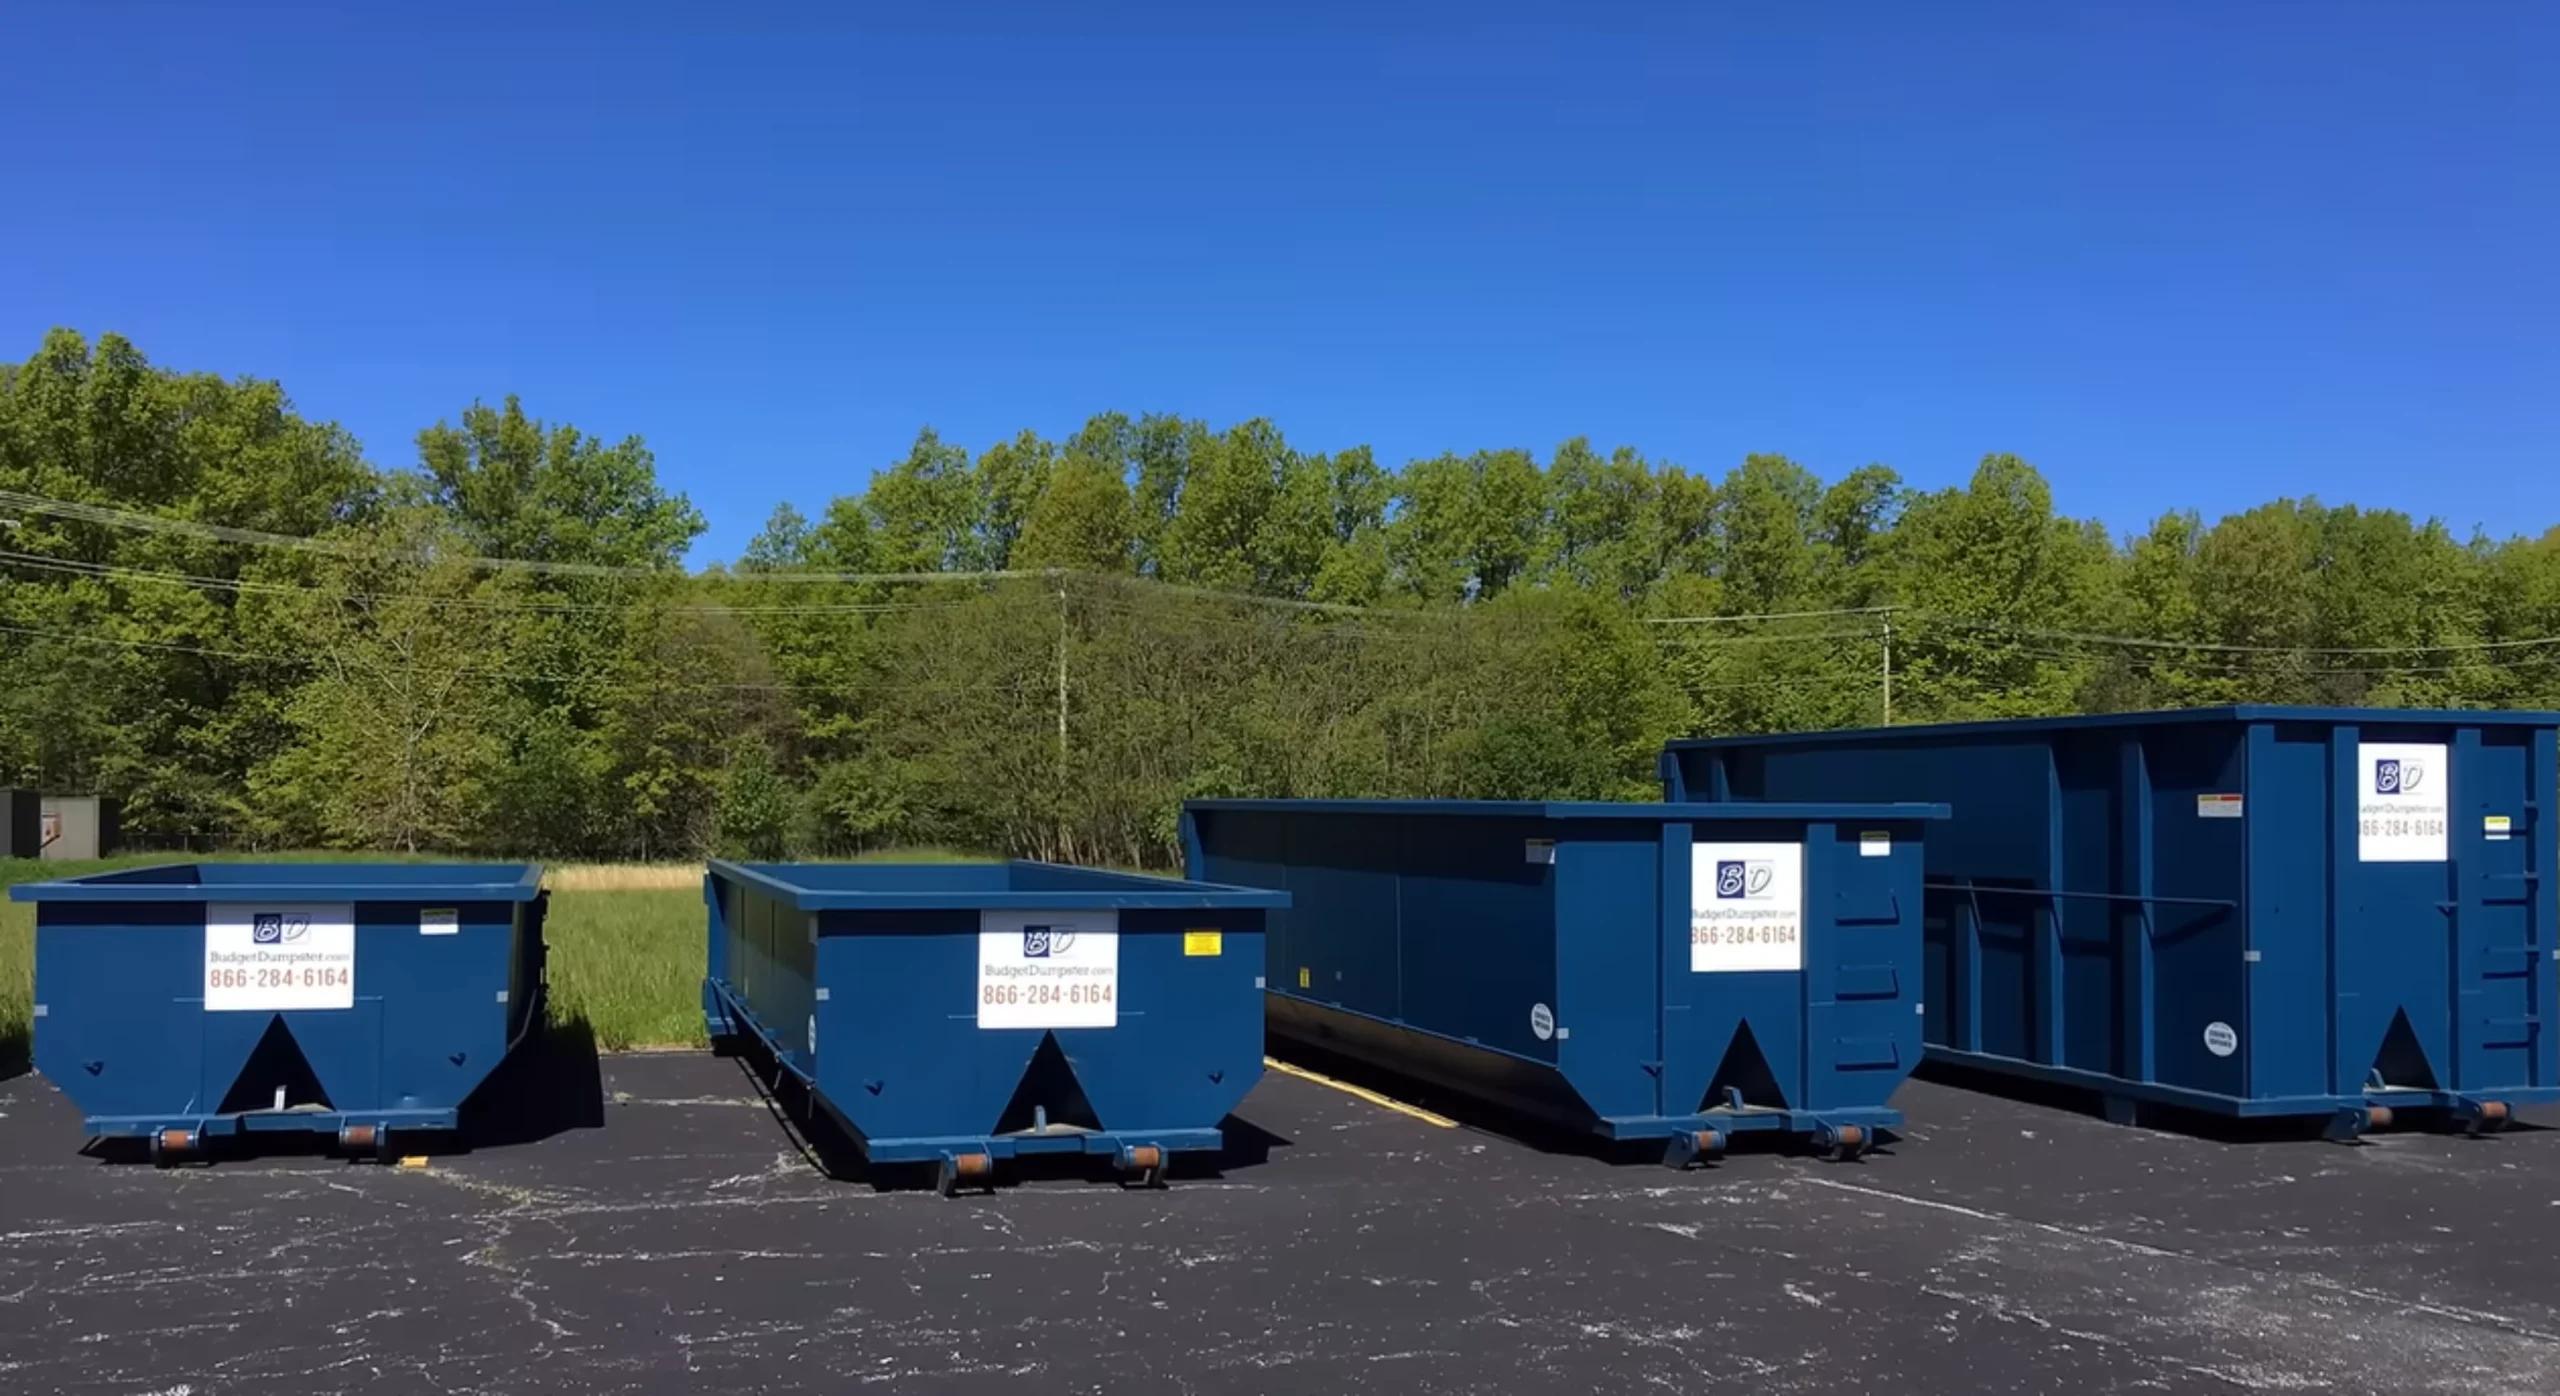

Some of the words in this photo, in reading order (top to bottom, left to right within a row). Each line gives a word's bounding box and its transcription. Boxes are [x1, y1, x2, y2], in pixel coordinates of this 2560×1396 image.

[2361, 819, 2443, 836] 66-284-6164
[210, 951, 349, 965] BudgetDumpster.com
[210, 967, 349, 988] 866-284-6164
[984, 964, 1114, 979] BudgetDumpster.com
[983, 983, 1113, 1005] 866-284-6164
